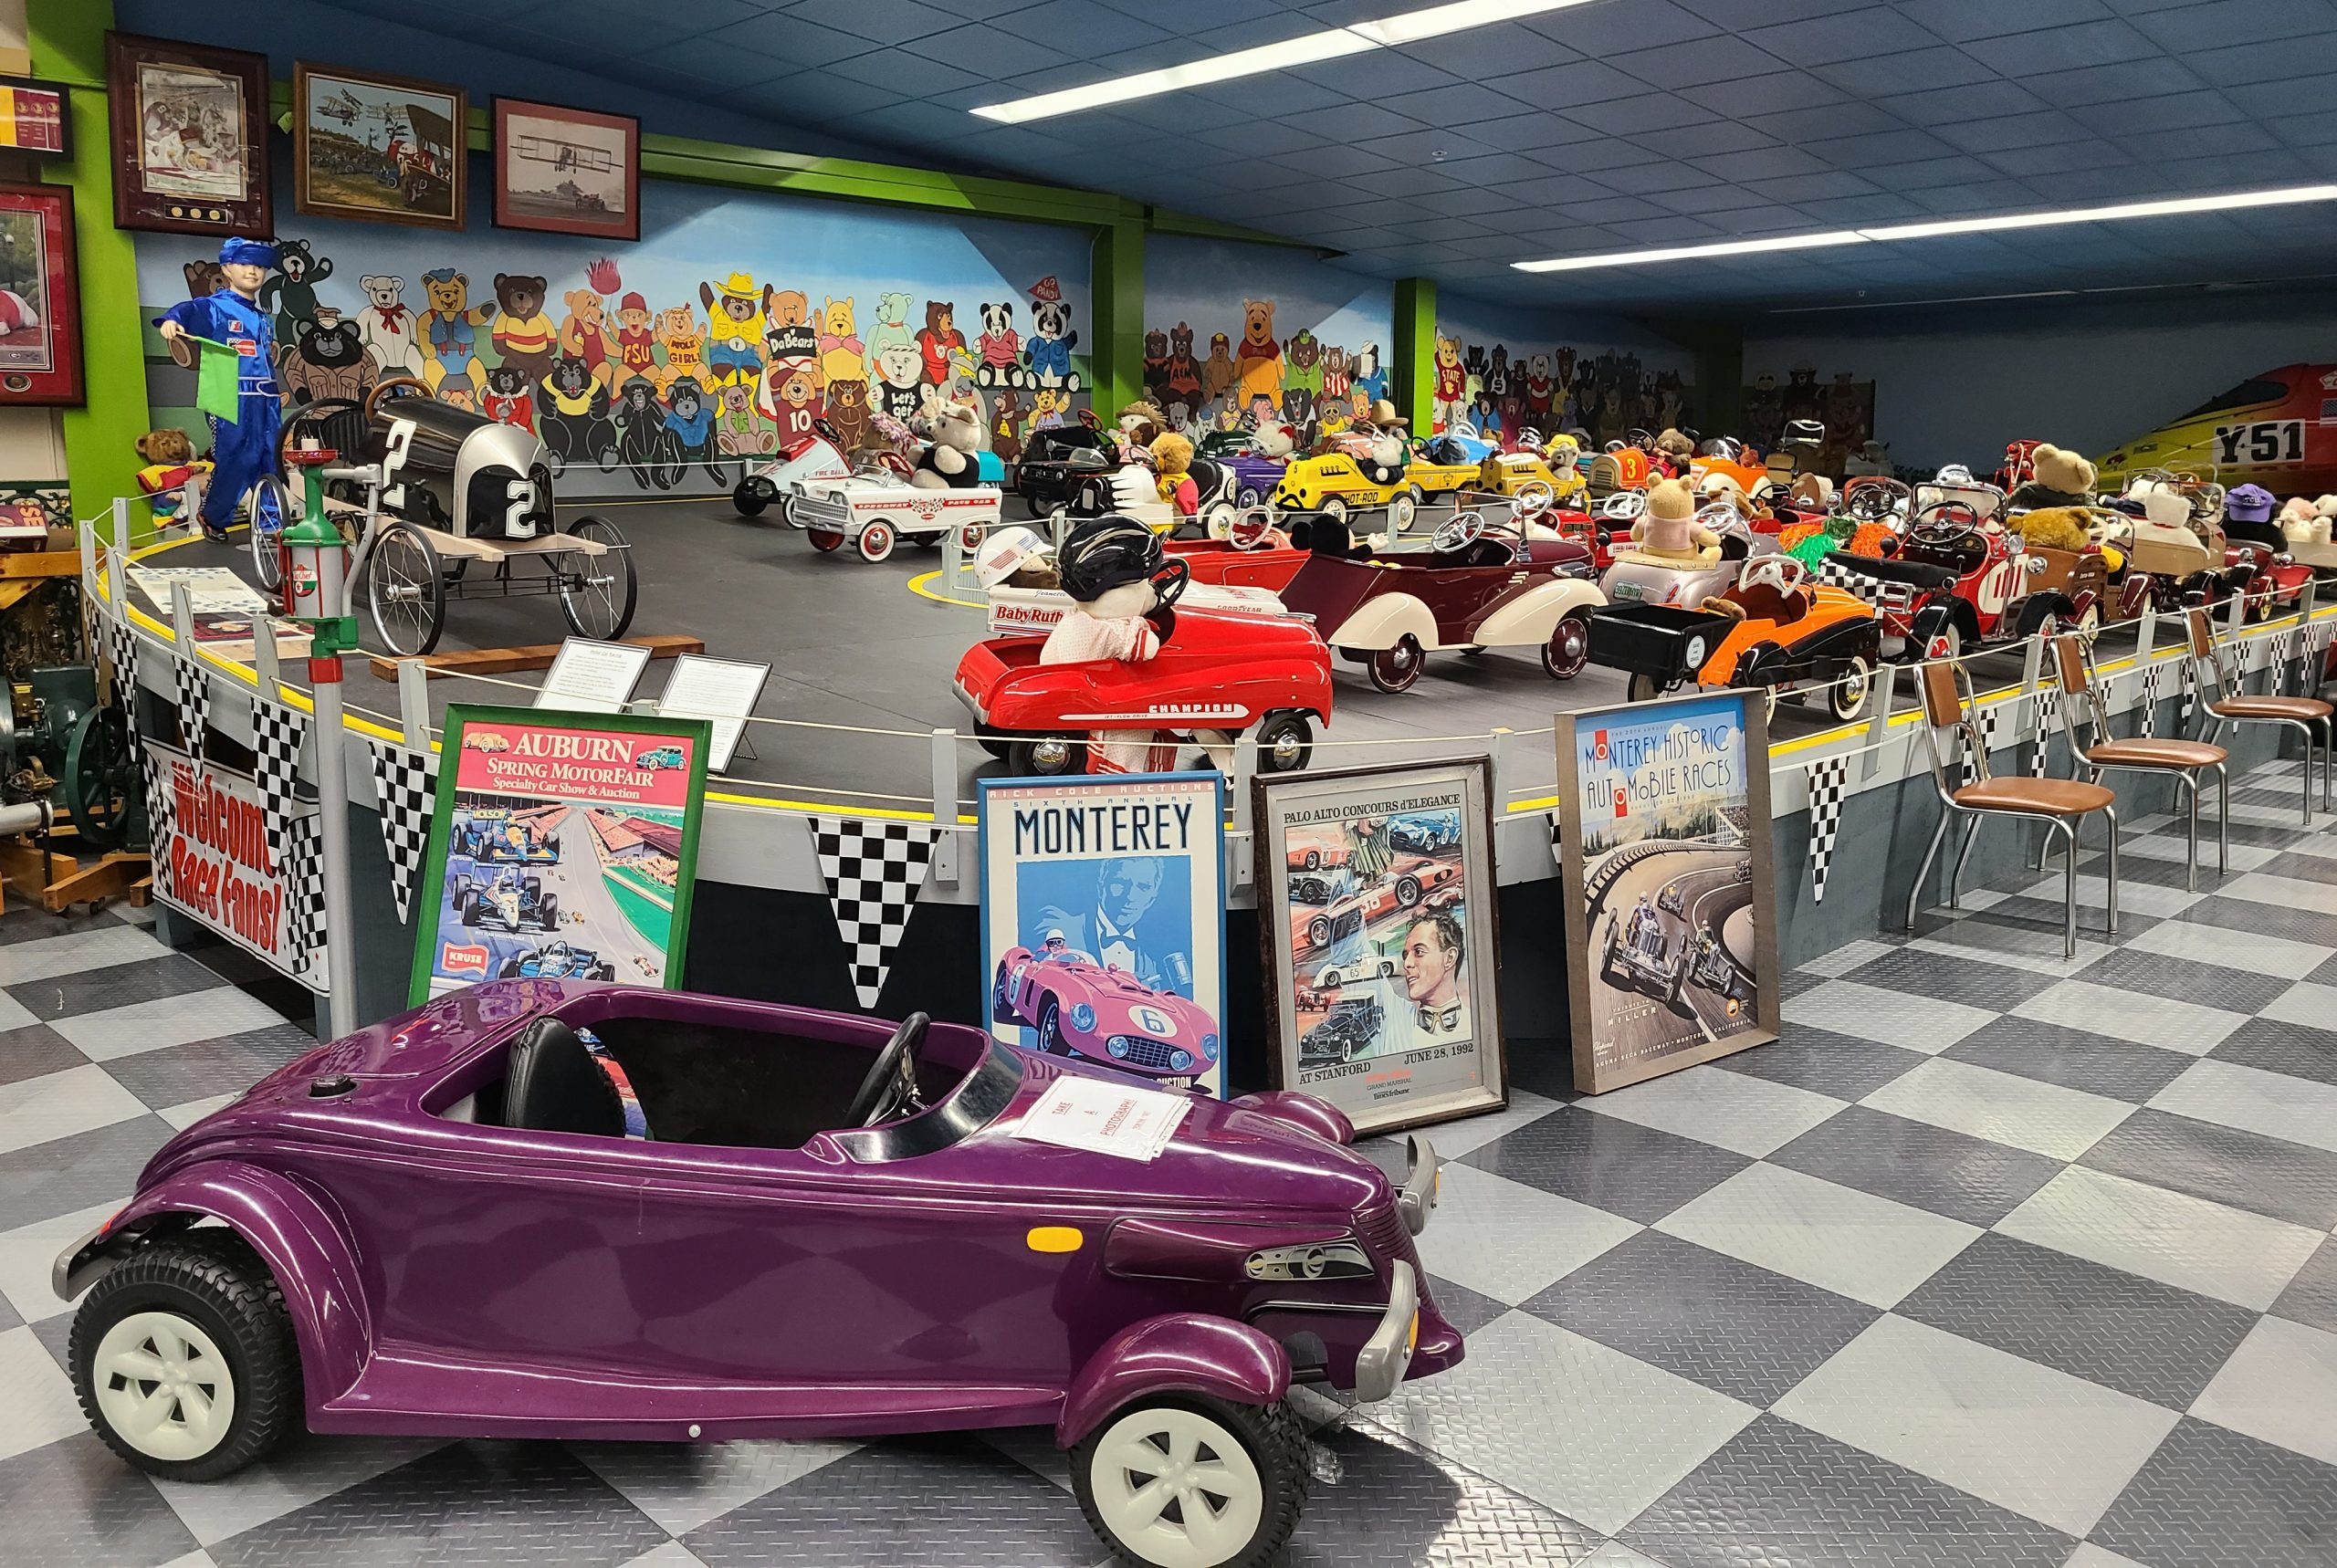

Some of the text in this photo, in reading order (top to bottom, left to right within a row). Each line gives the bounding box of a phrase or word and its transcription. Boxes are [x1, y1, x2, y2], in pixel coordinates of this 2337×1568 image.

[624, 343, 649, 364] FSU
[1442, 369, 1461, 383] STATE
[1493, 380, 1504, 392] S
[891, 391, 916, 406] Let's
[790, 412, 812, 433] 10
[383, 419, 417, 509] 2
[1294, 465, 1298, 474] 5
[1627, 458, 1636, 479] 3
[1345, 491, 1378, 504] HOT-ROD
[506, 480, 536, 538] 2
[1148, 703, 1232, 714] CHAMPION
[512, 733, 635, 764] AUBURN
[486, 758, 548, 779] SPRING
[1683, 758, 1731, 792] RACES
[493, 777, 639, 800] Specialty Car Show & Auction
[990, 782, 1215, 799] RICK COLE AUCTIONS
[1014, 796, 1193, 808] SIXTH ANNUAL
[1284, 794, 1461, 823] PALO ALTO CONCOURS d'ELEGANCE
[1014, 803, 1192, 856] MONTEREY
[171, 834, 281, 956] Race Fans!
[449, 952, 482, 964] KRUSE
[1141, 1009, 1165, 1033] 6
[1608, 1006, 1657, 1027] MILLER
[1404, 1042, 1474, 1065] JUNE 28, 1992
[1640, 1041, 1670, 1056] RACEWAY
[1676, 1031, 1705, 1045] MONTERE
[1299, 1072, 1313, 1085] AT
[1315, 1061, 1371, 1082] STANFORD
[1367, 1077, 1412, 1092] GRAND MARSHAL
[1052, 1102, 1070, 1115] TAKE
